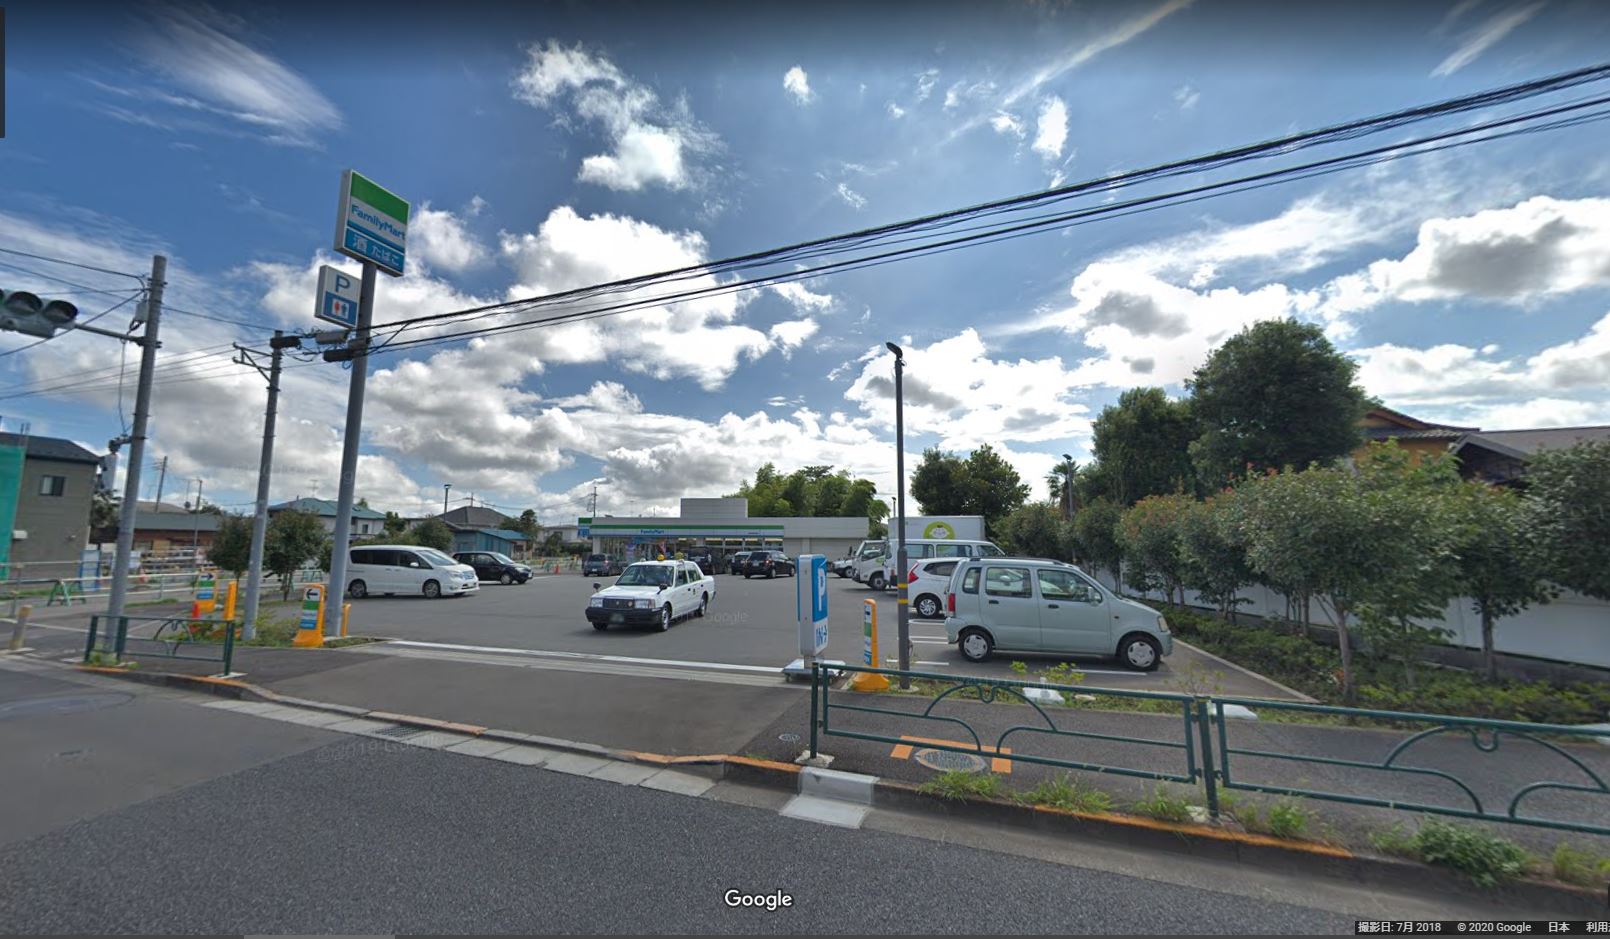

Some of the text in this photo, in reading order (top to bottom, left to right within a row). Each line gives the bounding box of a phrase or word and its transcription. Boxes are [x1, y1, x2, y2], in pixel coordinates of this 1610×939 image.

[351, 204, 406, 241] FamilyMart
[371, 245, 400, 266] たばこ
[335, 274, 351, 293] P
[817, 567, 826, 612] P
